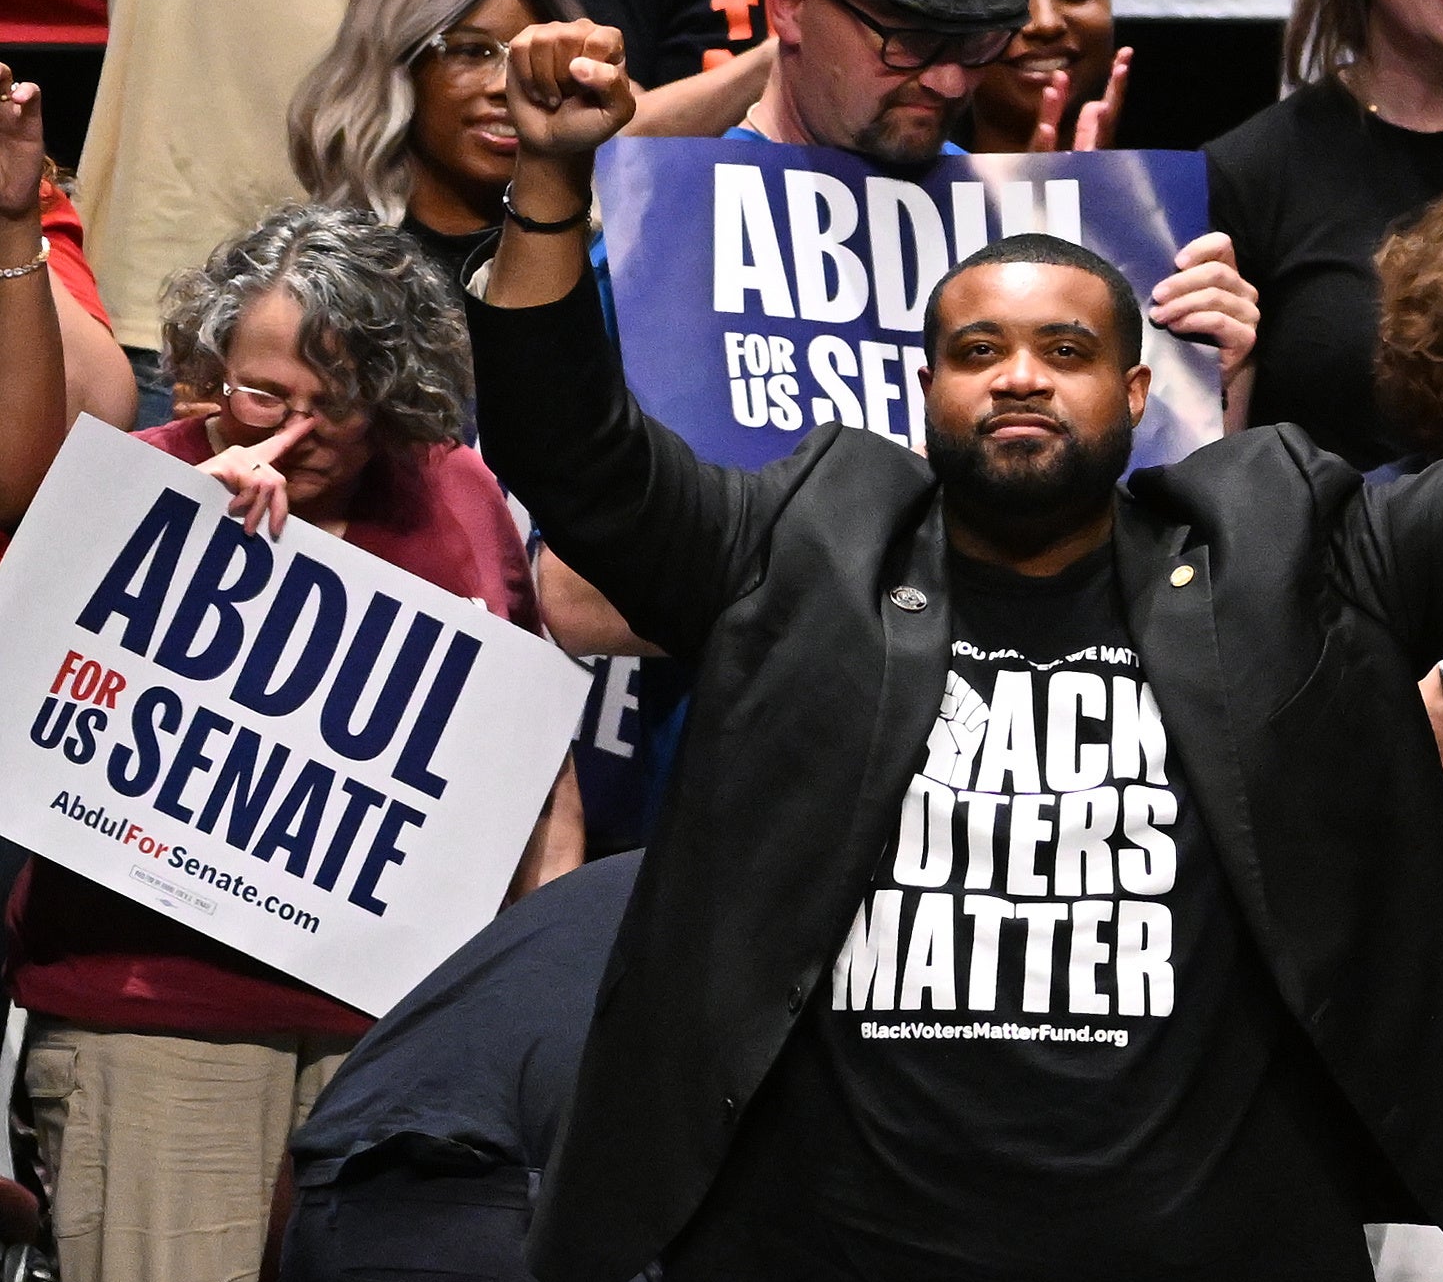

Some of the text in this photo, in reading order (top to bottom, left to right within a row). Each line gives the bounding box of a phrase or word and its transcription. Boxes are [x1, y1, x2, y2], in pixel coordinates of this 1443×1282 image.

[724, 332, 795, 379] FOR
[730, 372, 803, 432] US
[49, 650, 126, 710] FOR
[75, 488, 482, 800] ABDUL
[951, 640, 986, 660] YOU
[1100, 645, 1139, 668] MATT
[978, 670, 1168, 793] ACK
[30, 697, 107, 765] US
[107, 685, 427, 917] SENATE
[893, 773, 1178, 897] OTERS
[50, 789, 320, 934] AbdulForSenate.com
[832, 890, 1174, 1017] MATTER
[861, 1020, 1129, 1048] BlackVotersMatterFund.org
